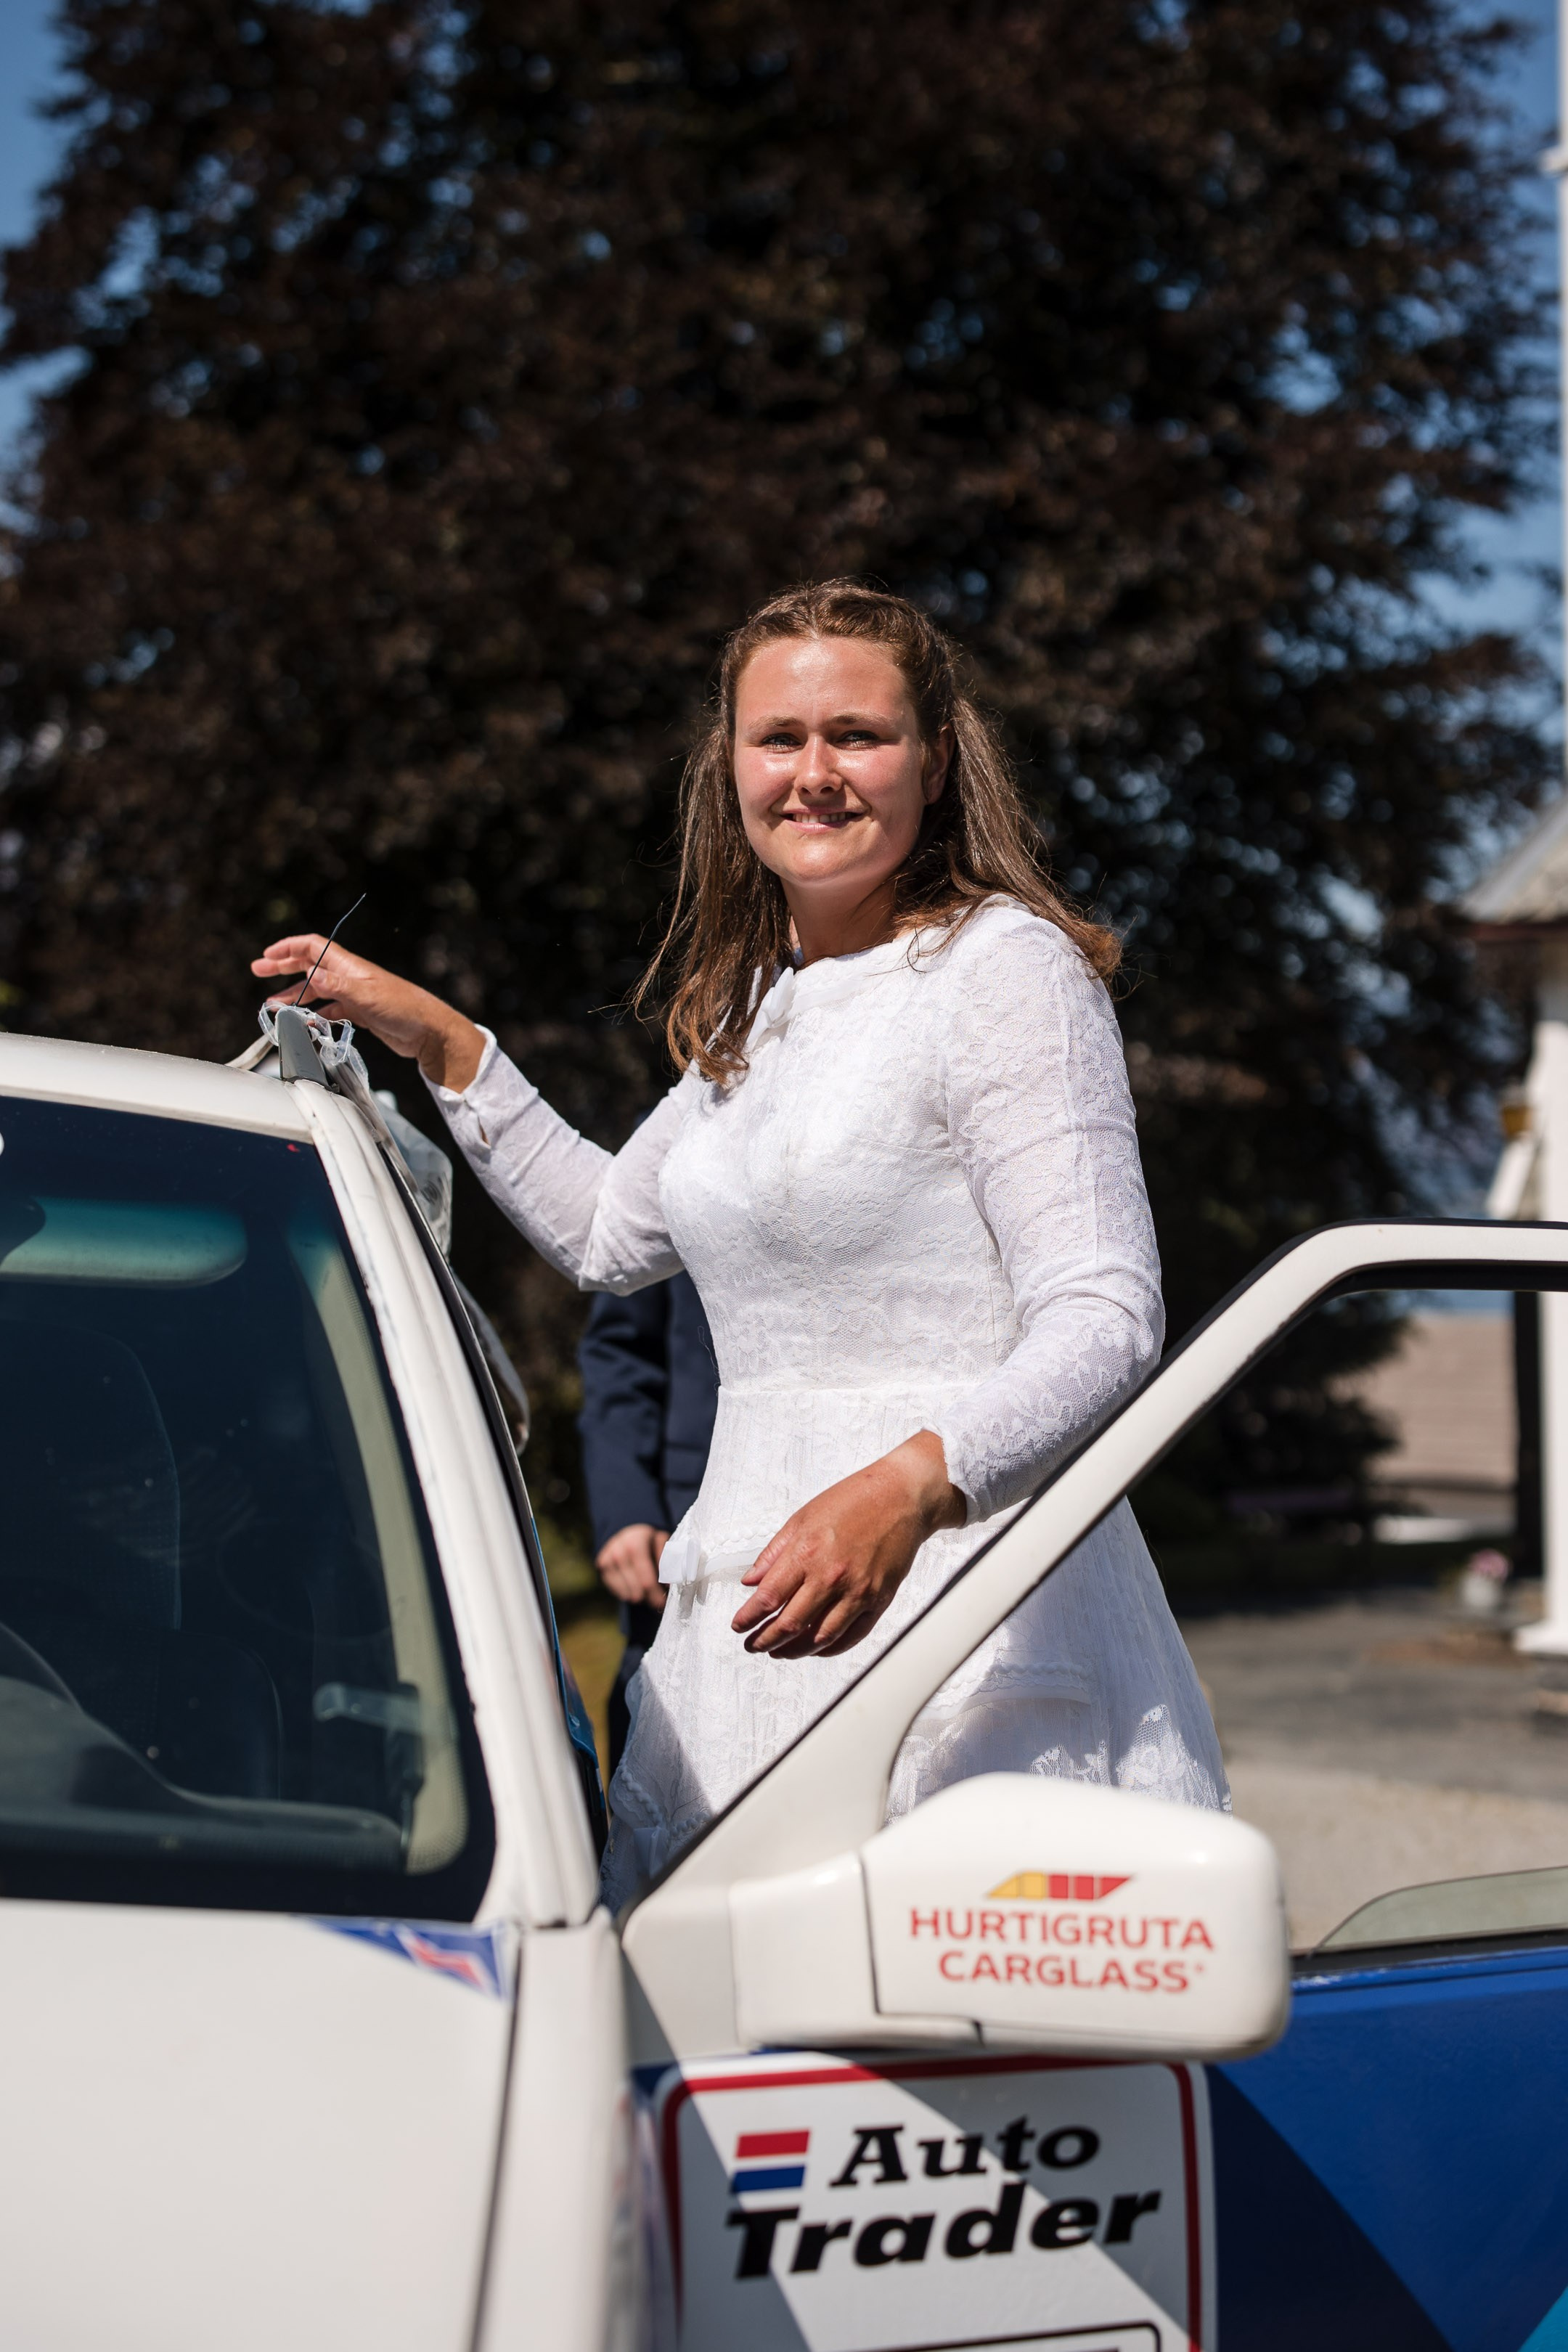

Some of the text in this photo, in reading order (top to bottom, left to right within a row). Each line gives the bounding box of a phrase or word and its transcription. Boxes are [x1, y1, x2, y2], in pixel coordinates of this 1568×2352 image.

[910, 1908, 1214, 1951] HURTIGRUTA
[829, 2116, 1100, 2188] Auto
[727, 2182, 1161, 2279] Trader
